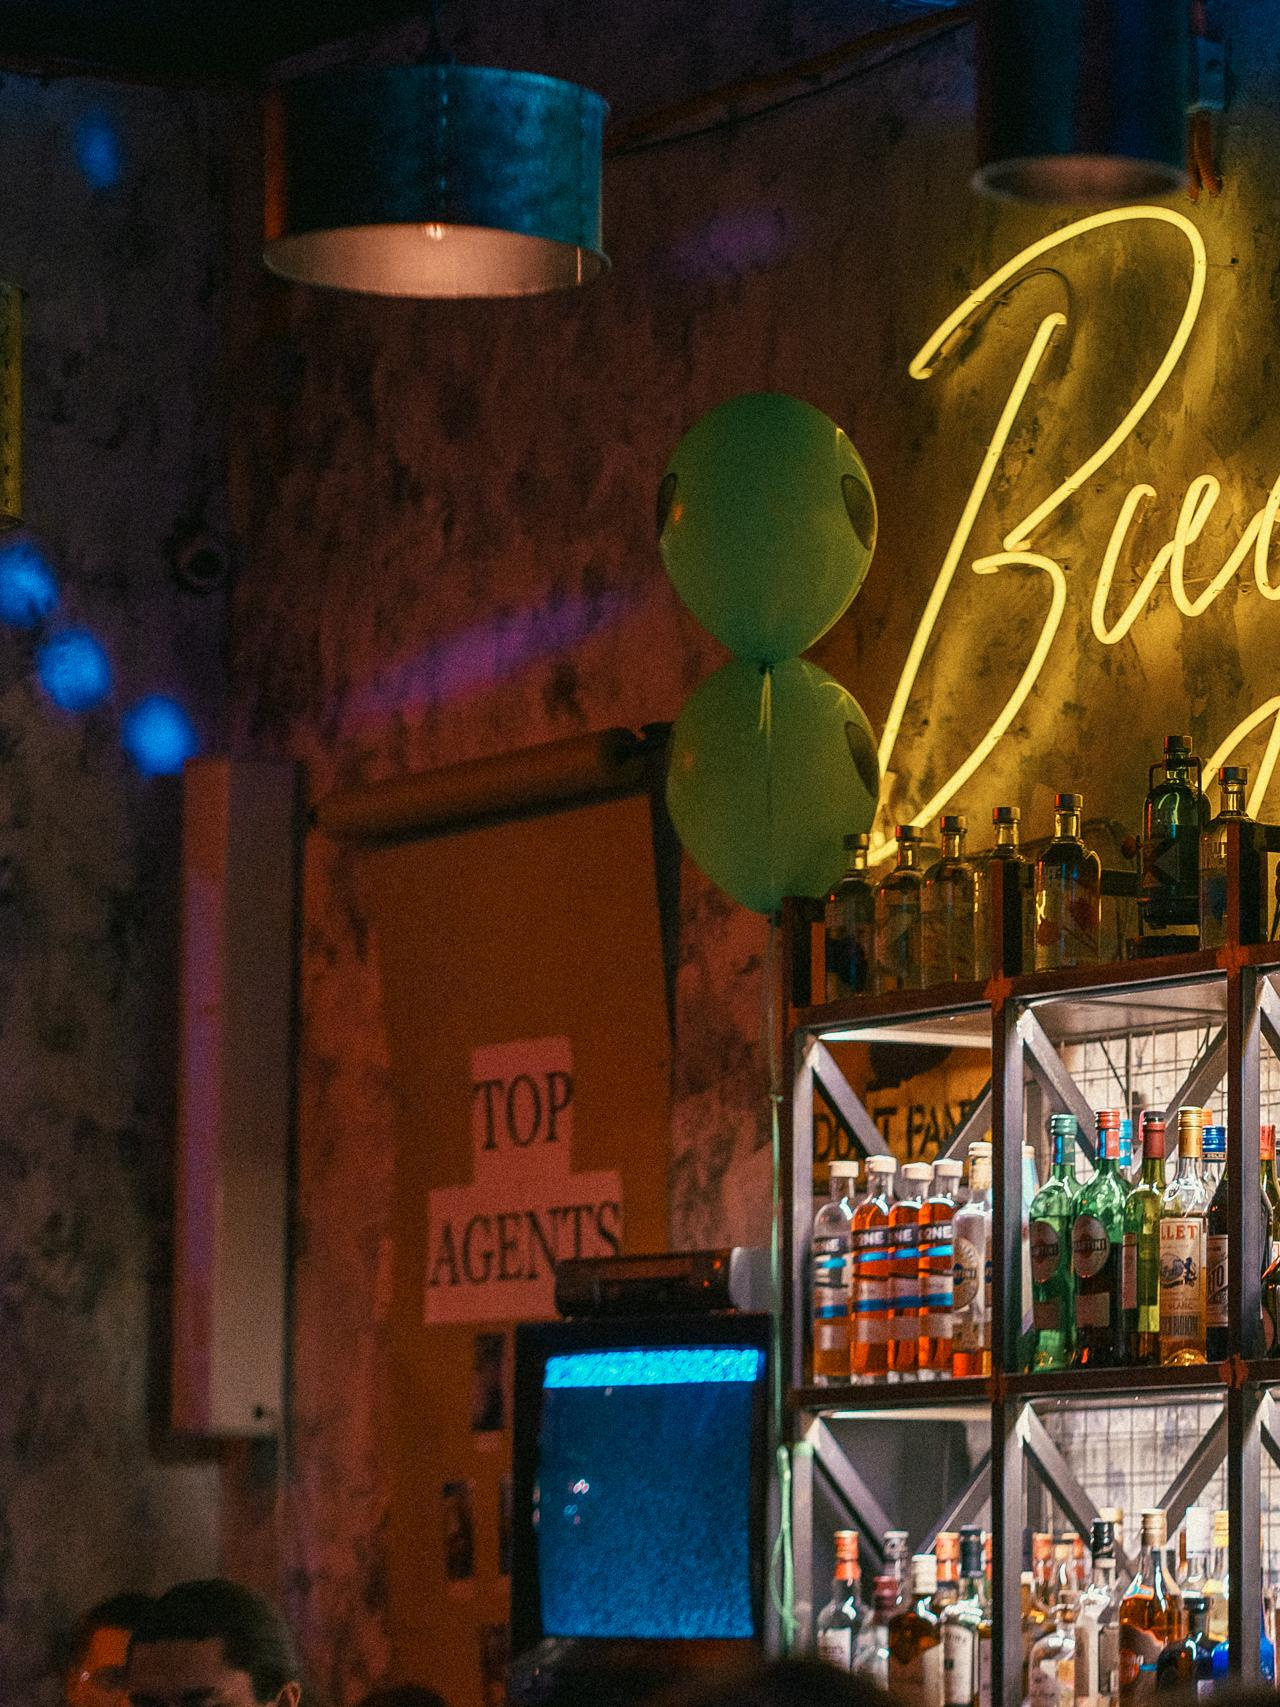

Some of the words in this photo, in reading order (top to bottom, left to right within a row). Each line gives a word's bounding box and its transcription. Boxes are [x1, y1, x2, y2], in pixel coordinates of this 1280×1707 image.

[472, 1072, 575, 1151] TOP
[429, 1202, 622, 1287] AGENTS
[1161, 1224, 1198, 1241] LLET
